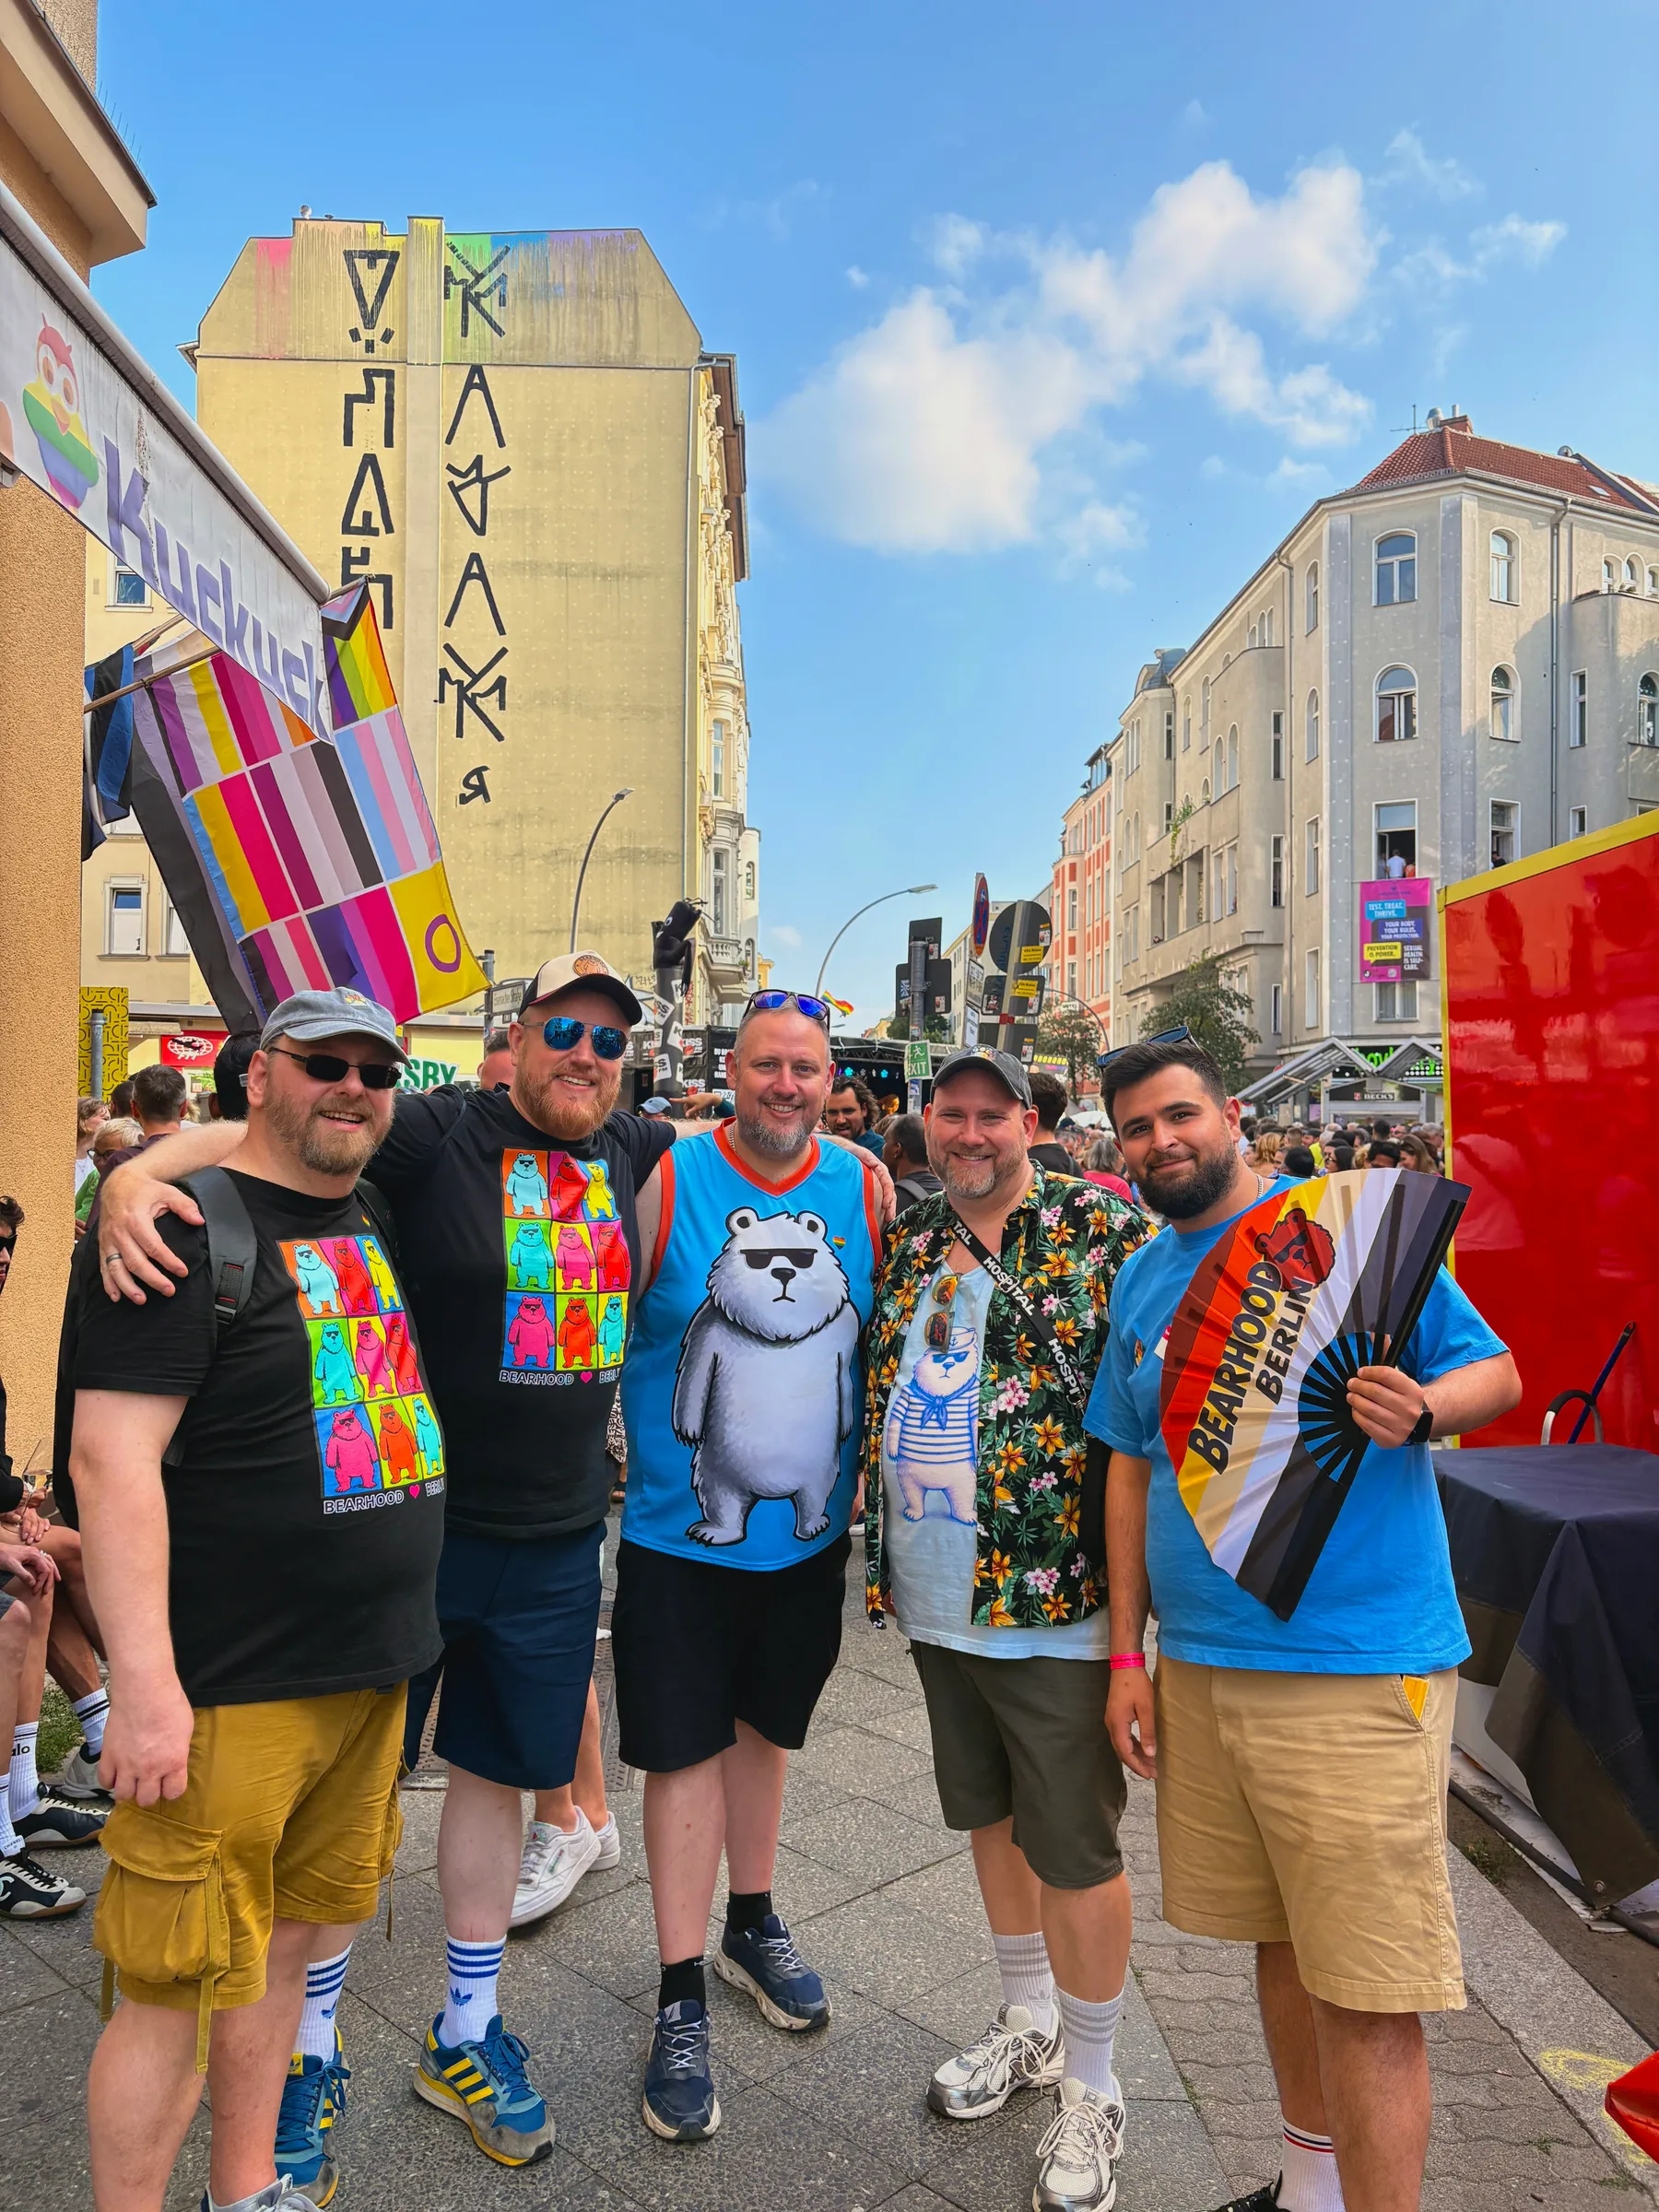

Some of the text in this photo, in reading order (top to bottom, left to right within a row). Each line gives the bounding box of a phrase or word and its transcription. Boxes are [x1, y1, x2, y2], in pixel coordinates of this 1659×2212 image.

[1048, 1338, 1080, 1396] HOSPI
[1187, 1261, 1284, 1475] BEARHOOD
[1255, 1276, 1314, 1405] BERLIN
[499, 1370, 574, 1385] BEARHOOD
[324, 1489, 405, 1514] BEARHOOD
